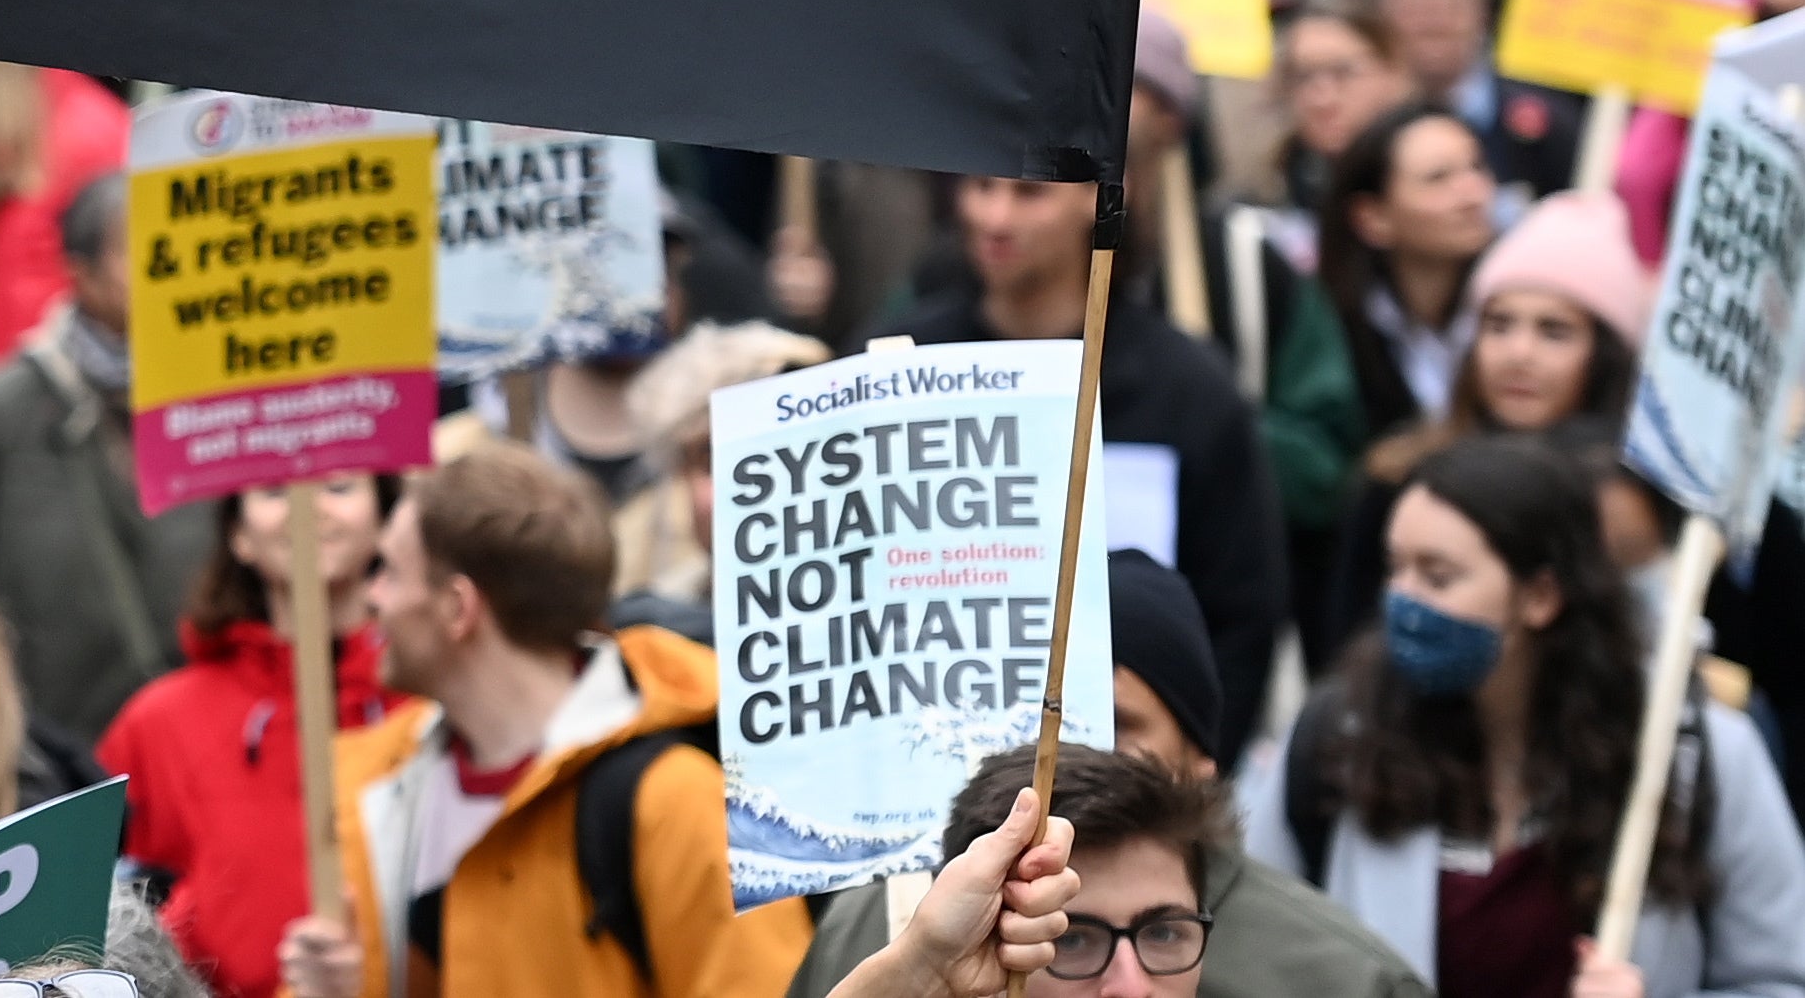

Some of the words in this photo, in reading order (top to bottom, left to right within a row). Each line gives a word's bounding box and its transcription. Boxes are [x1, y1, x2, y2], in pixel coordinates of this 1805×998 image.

[169, 154, 394, 223] Migrants
[148, 234, 179, 282] &
[197, 211, 418, 270] refugees
[175, 271, 390, 328] welcome
[224, 326, 336, 374] here
[776, 373, 902, 422] Socialist
[906, 364, 1024, 394] Worker
[732, 415, 1020, 507] SYSTEM
[734, 476, 1040, 564] CHANGE
[887, 546, 932, 565] One
[942, 543, 1045, 563] solution:
[736, 547, 874, 627] NOT
[888, 569, 1009, 590] revolution
[737, 596, 1051, 685] CLIMATE
[739, 658, 1045, 745] CHANGE
